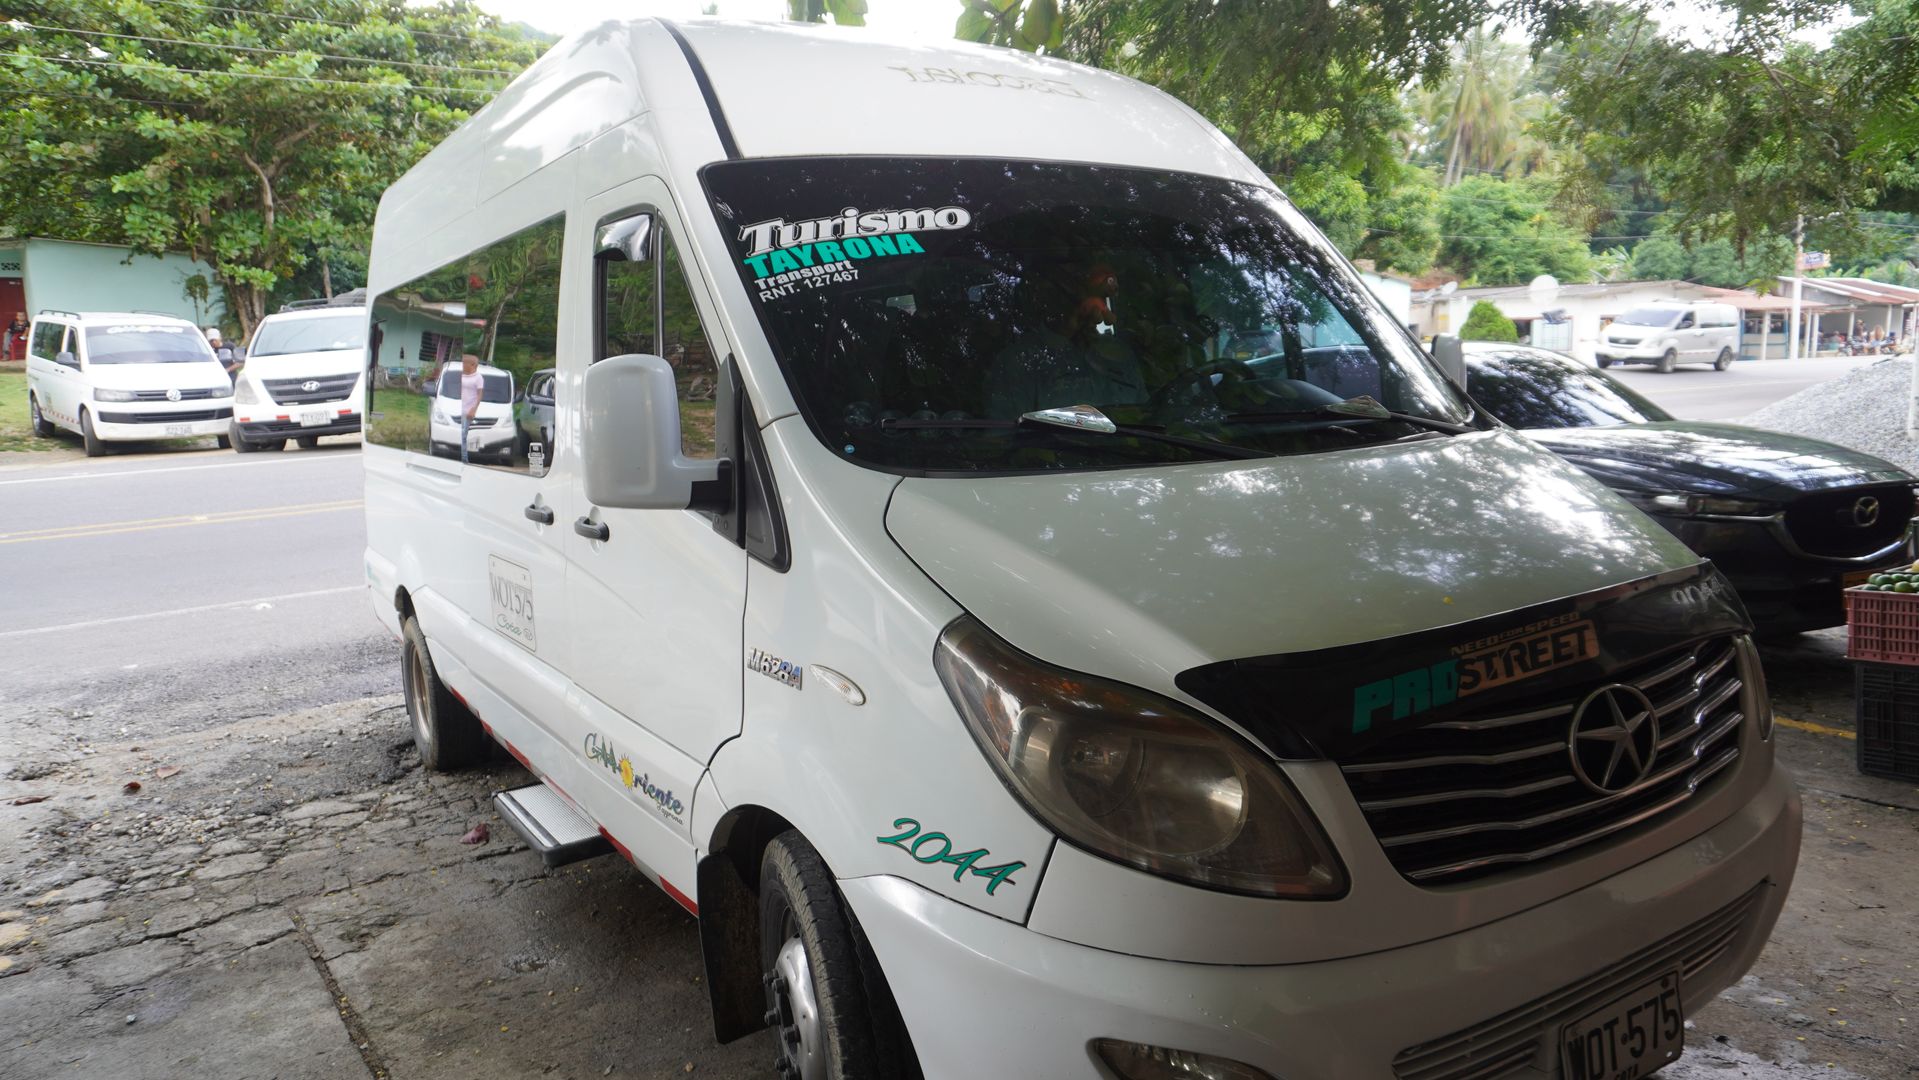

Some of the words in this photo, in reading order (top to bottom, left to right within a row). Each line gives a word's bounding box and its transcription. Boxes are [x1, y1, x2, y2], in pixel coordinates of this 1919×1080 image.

[738, 206, 971, 257] Turismo
[744, 233, 925, 278] TAYRONA
[754, 260, 854, 290] Transport
[759, 284, 800, 303] RNT.
[803, 269, 859, 289] 127467
[1452, 636, 1499, 656] NEED
[1498, 626, 1525, 641] FOR
[1526, 612, 1580, 634] SPEED
[1456, 624, 1591, 691] STREET
[877, 817, 1027, 896] 2044
